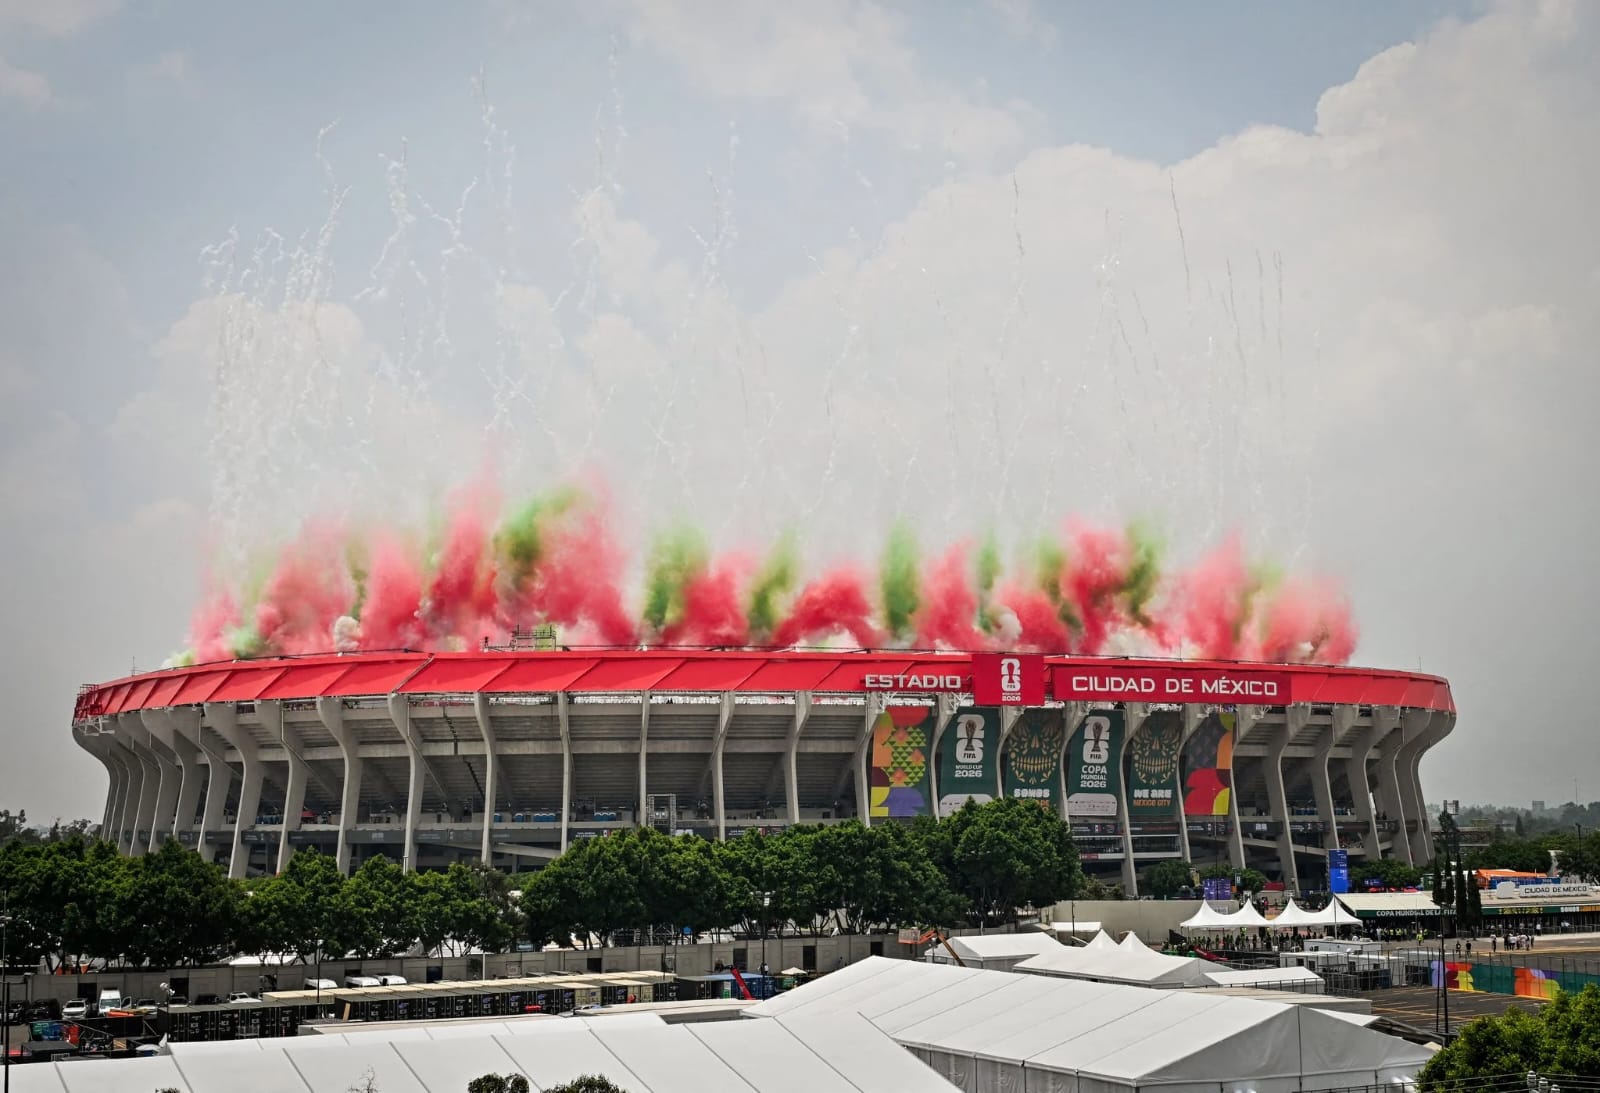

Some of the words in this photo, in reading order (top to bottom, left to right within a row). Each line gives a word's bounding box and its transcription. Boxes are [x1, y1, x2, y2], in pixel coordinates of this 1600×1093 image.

[865, 674, 961, 688] ESTADIO
[1072, 676, 1155, 693] CIUDAD
[1165, 678, 1193, 693] DE
[1201, 676, 1277, 695] MÉXICO
[954, 770, 983, 778] 2026
[1081, 765, 1107, 774] COPA
[1014, 788, 1050, 798] SOMOS
[1133, 789, 1149, 798] WE
[1150, 789, 1172, 798] ARE
